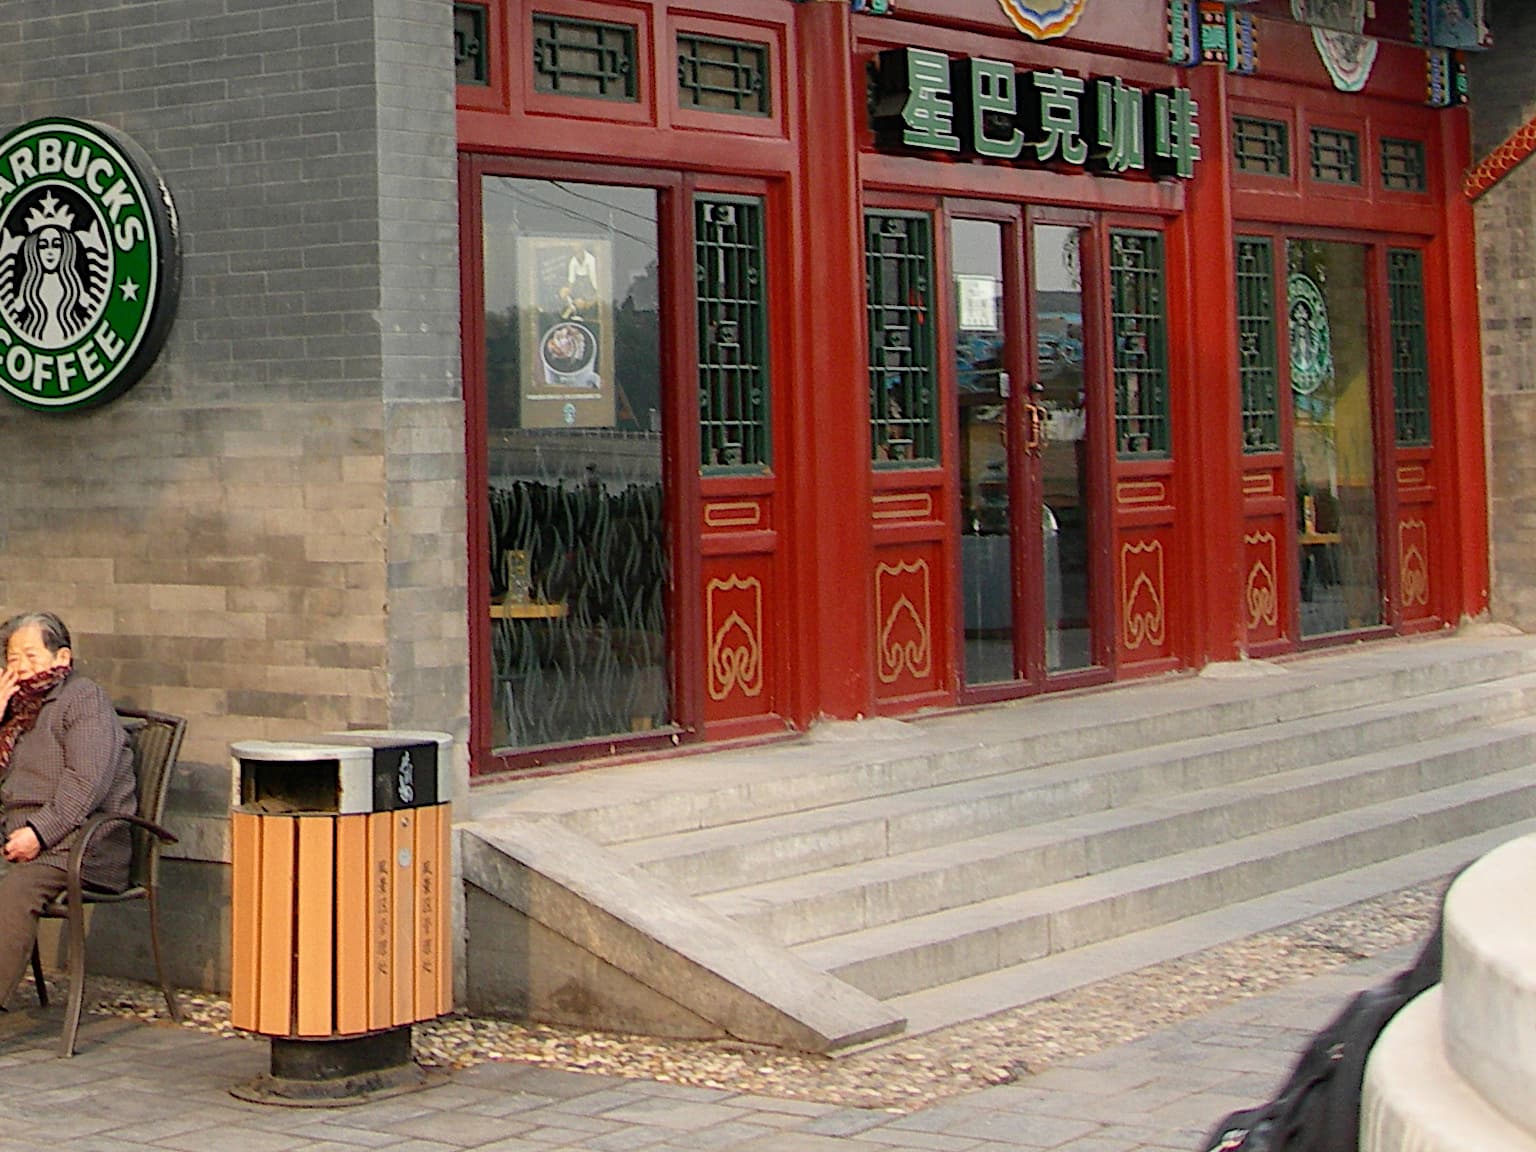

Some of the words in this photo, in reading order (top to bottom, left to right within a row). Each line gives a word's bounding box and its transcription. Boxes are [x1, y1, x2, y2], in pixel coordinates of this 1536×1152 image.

[901, 47, 1202, 179] 星巴克咖啡
